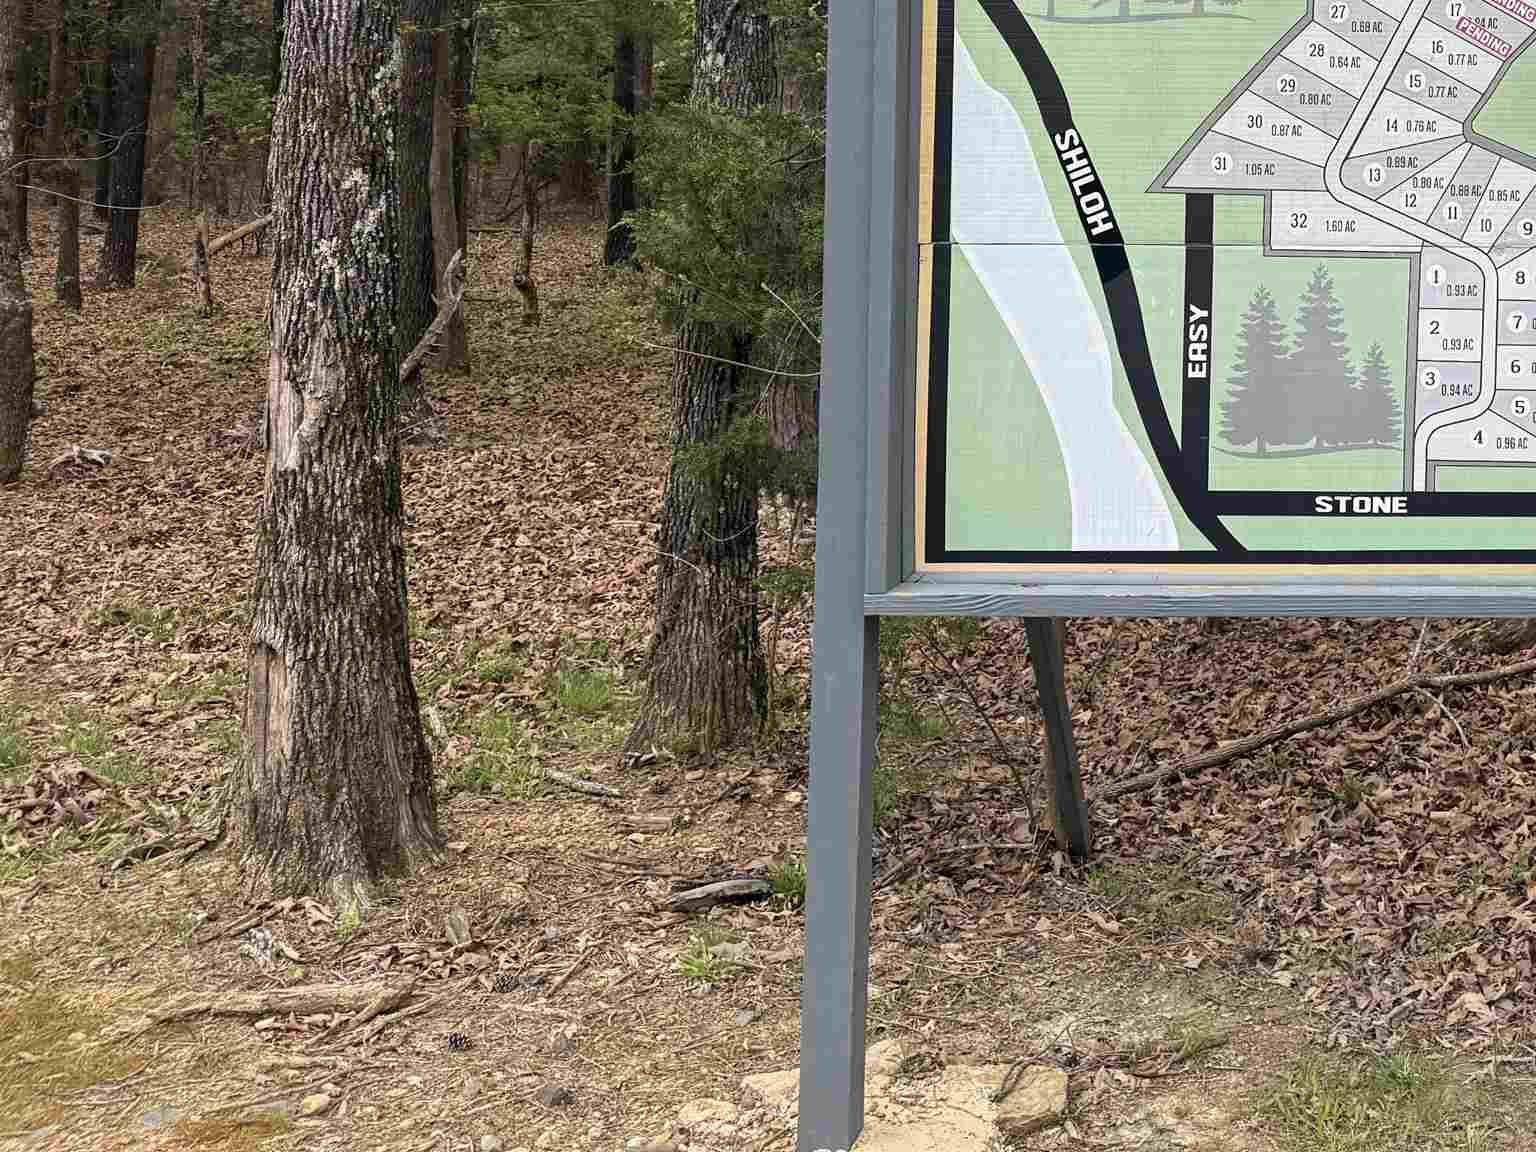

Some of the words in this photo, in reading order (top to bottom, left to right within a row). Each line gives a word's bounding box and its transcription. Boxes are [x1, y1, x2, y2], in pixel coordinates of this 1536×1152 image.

[1330, 5, 1346, 19] 27
[1450, 3, 1461, 17] 17
[1372, 21, 1383, 33] AC
[1487, 18, 1498, 29] AC
[1458, 20, 1511, 58] PENDING
[1309, 44, 1325, 57] 28
[1431, 40, 1444, 54] 16
[1350, 56, 1361, 68] AC
[1448, 54, 1466, 66] 0.77
[1467, 54, 1478, 66] AC
[1280, 79, 1296, 93] 29
[1409, 74, 1422, 88] 15
[1447, 86, 1458, 98] AC
[1320, 94, 1332, 105] AC
[1248, 115, 1263, 128] 30
[1291, 125, 1303, 137] AC
[1386, 118, 1398, 132] 14
[1426, 120, 1437, 133] AC
[1214, 157, 1227, 170] 31
[1264, 164, 1275, 176] AC
[1407, 156, 1419, 168] AC
[1055, 128, 1114, 236] SHILOH
[1369, 168, 1381, 182] 13
[1433, 177, 1444, 189] AC
[1471, 184, 1482, 196] AC
[1405, 193, 1417, 207] 12
[1510, 190, 1520, 201] AC
[1448, 206, 1457, 220] 11
[1290, 213, 1308, 228] 32
[1345, 220, 1356, 233] AC
[1480, 218, 1492, 232] 10
[1523, 222, 1533, 236] 9
[1433, 270, 1439, 284] 1
[1515, 271, 1525, 285] 8
[1447, 285, 1466, 297] 0.93
[1467, 285, 1478, 297] AC
[1429, 321, 1440, 335] 2
[1512, 315, 1522, 329] 7
[1188, 304, 1209, 378] EASY
[1442, 338, 1462, 351] 0.93
[1463, 338, 1474, 351] AC
[1511, 360, 1521, 374] 6
[1425, 372, 1436, 386] 3
[1462, 384, 1473, 396] AC
[1515, 400, 1525, 414] 5
[1473, 430, 1482, 444] 4
[1518, 437, 1528, 449] AC
[1315, 496, 1407, 513] STONE
